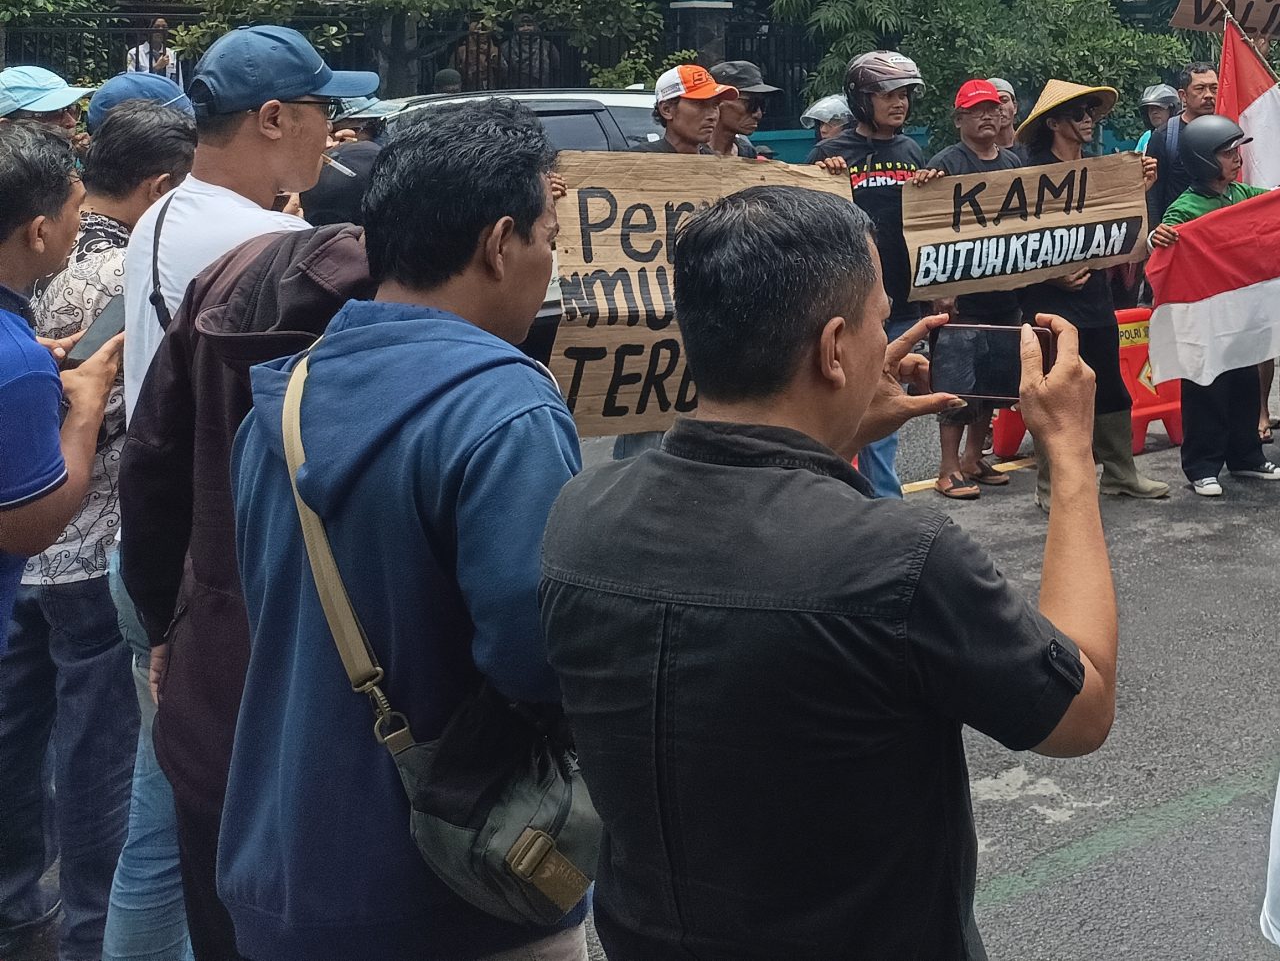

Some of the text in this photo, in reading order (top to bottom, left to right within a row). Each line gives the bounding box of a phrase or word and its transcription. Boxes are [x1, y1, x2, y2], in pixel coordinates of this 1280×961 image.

[951, 167, 1088, 233] KAMI
[914, 237, 1006, 287] BUTUH
[1006, 222, 1128, 275] KEADILAN
[1119, 327, 1142, 341] POLRI
